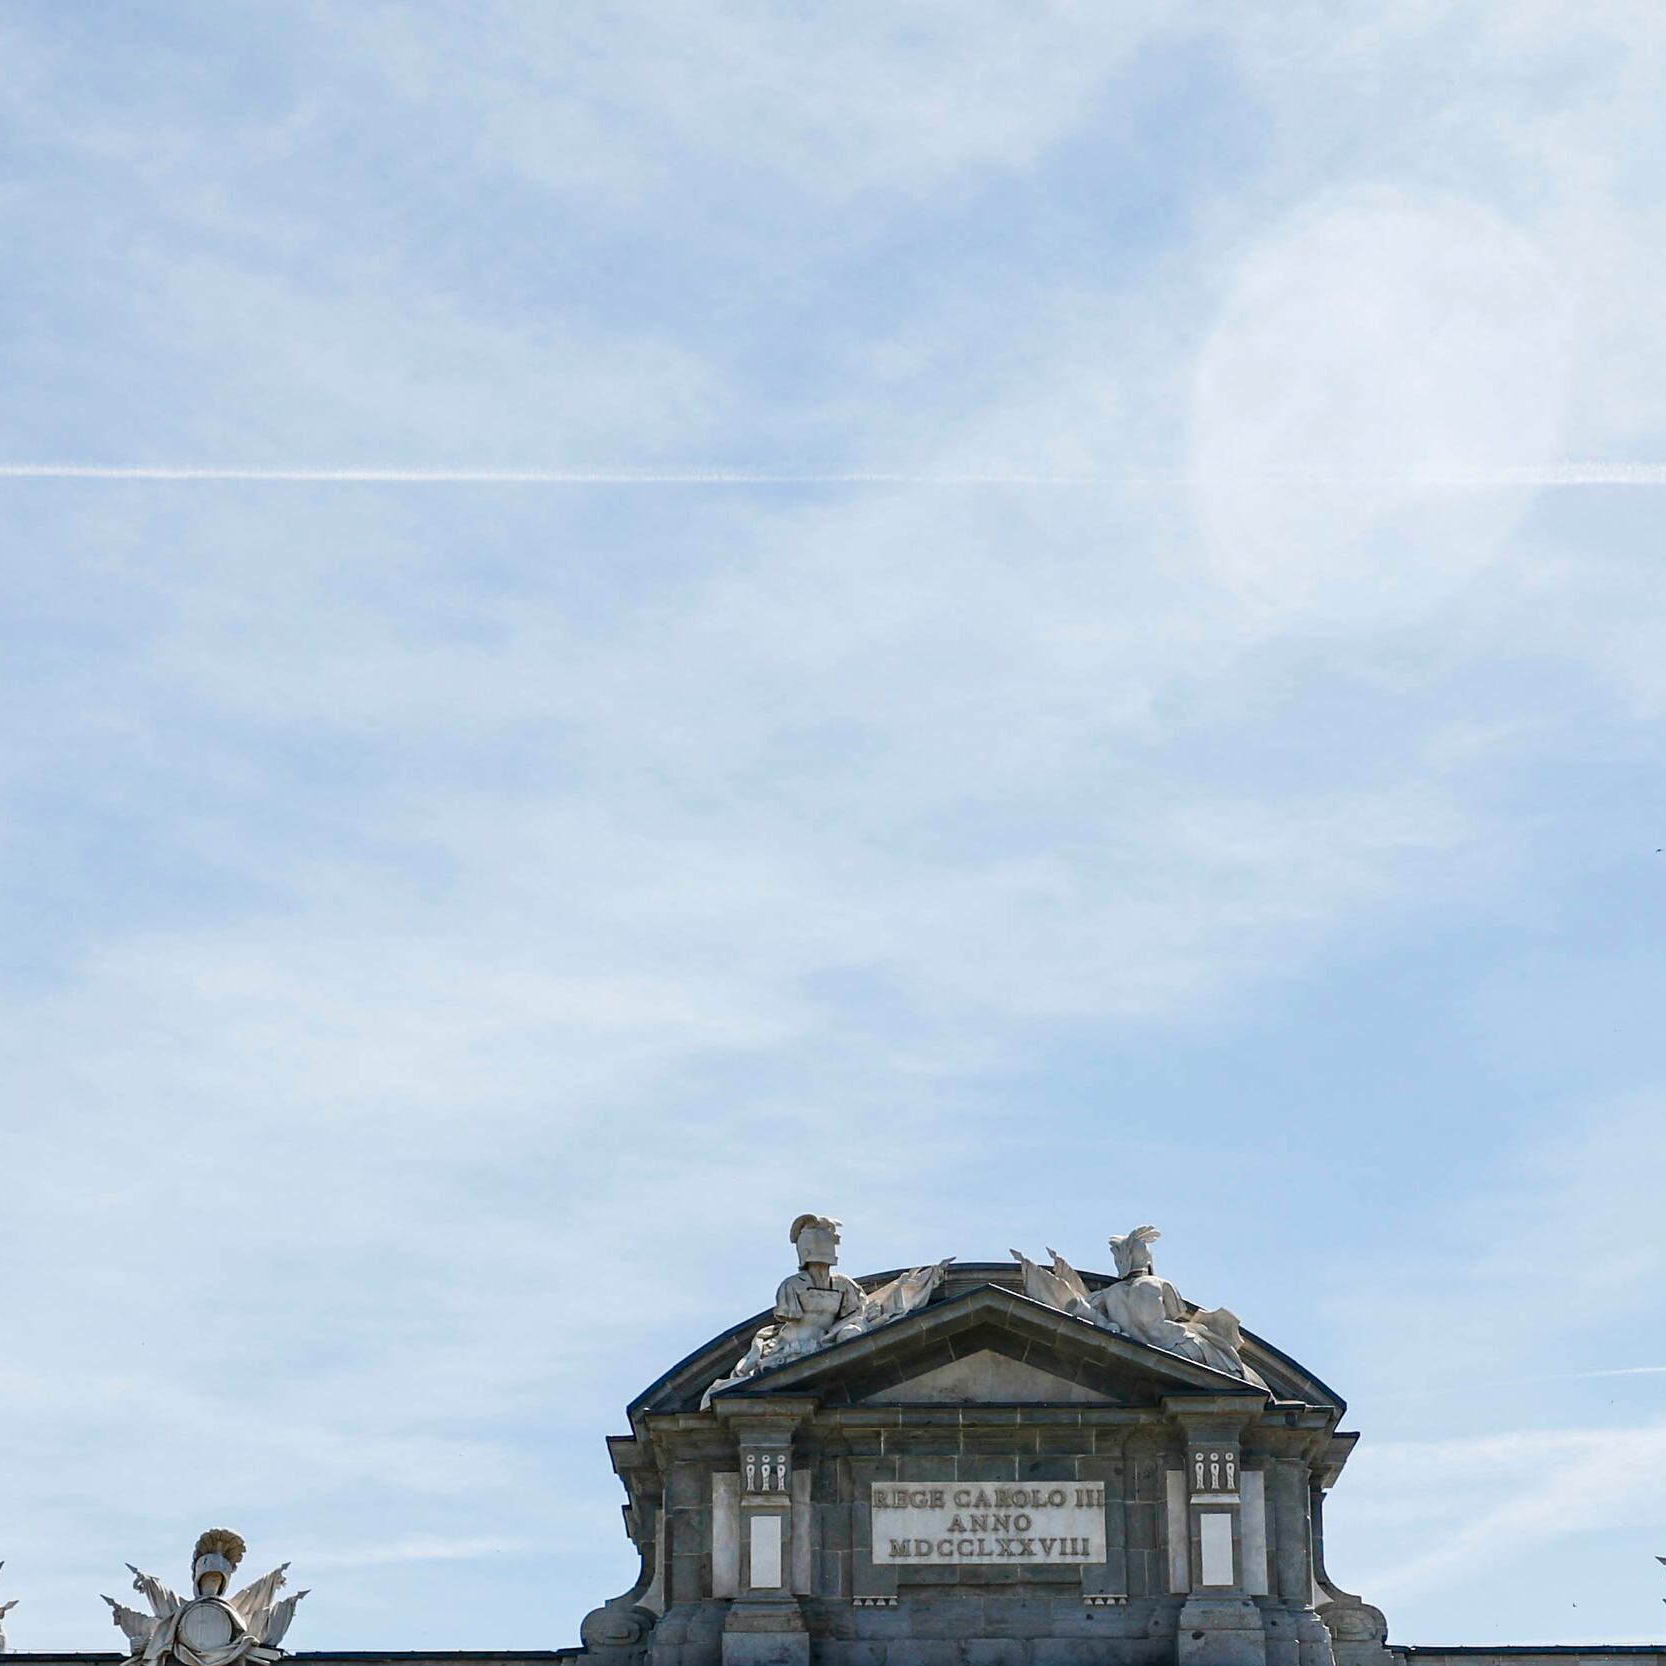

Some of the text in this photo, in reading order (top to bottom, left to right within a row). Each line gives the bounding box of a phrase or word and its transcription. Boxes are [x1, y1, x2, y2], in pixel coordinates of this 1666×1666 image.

[873, 1489, 1105, 1508] REGE CAROLO III
[947, 1514, 1032, 1532] ANNO
[889, 1538, 1091, 1557] MDCCLXXVIII
